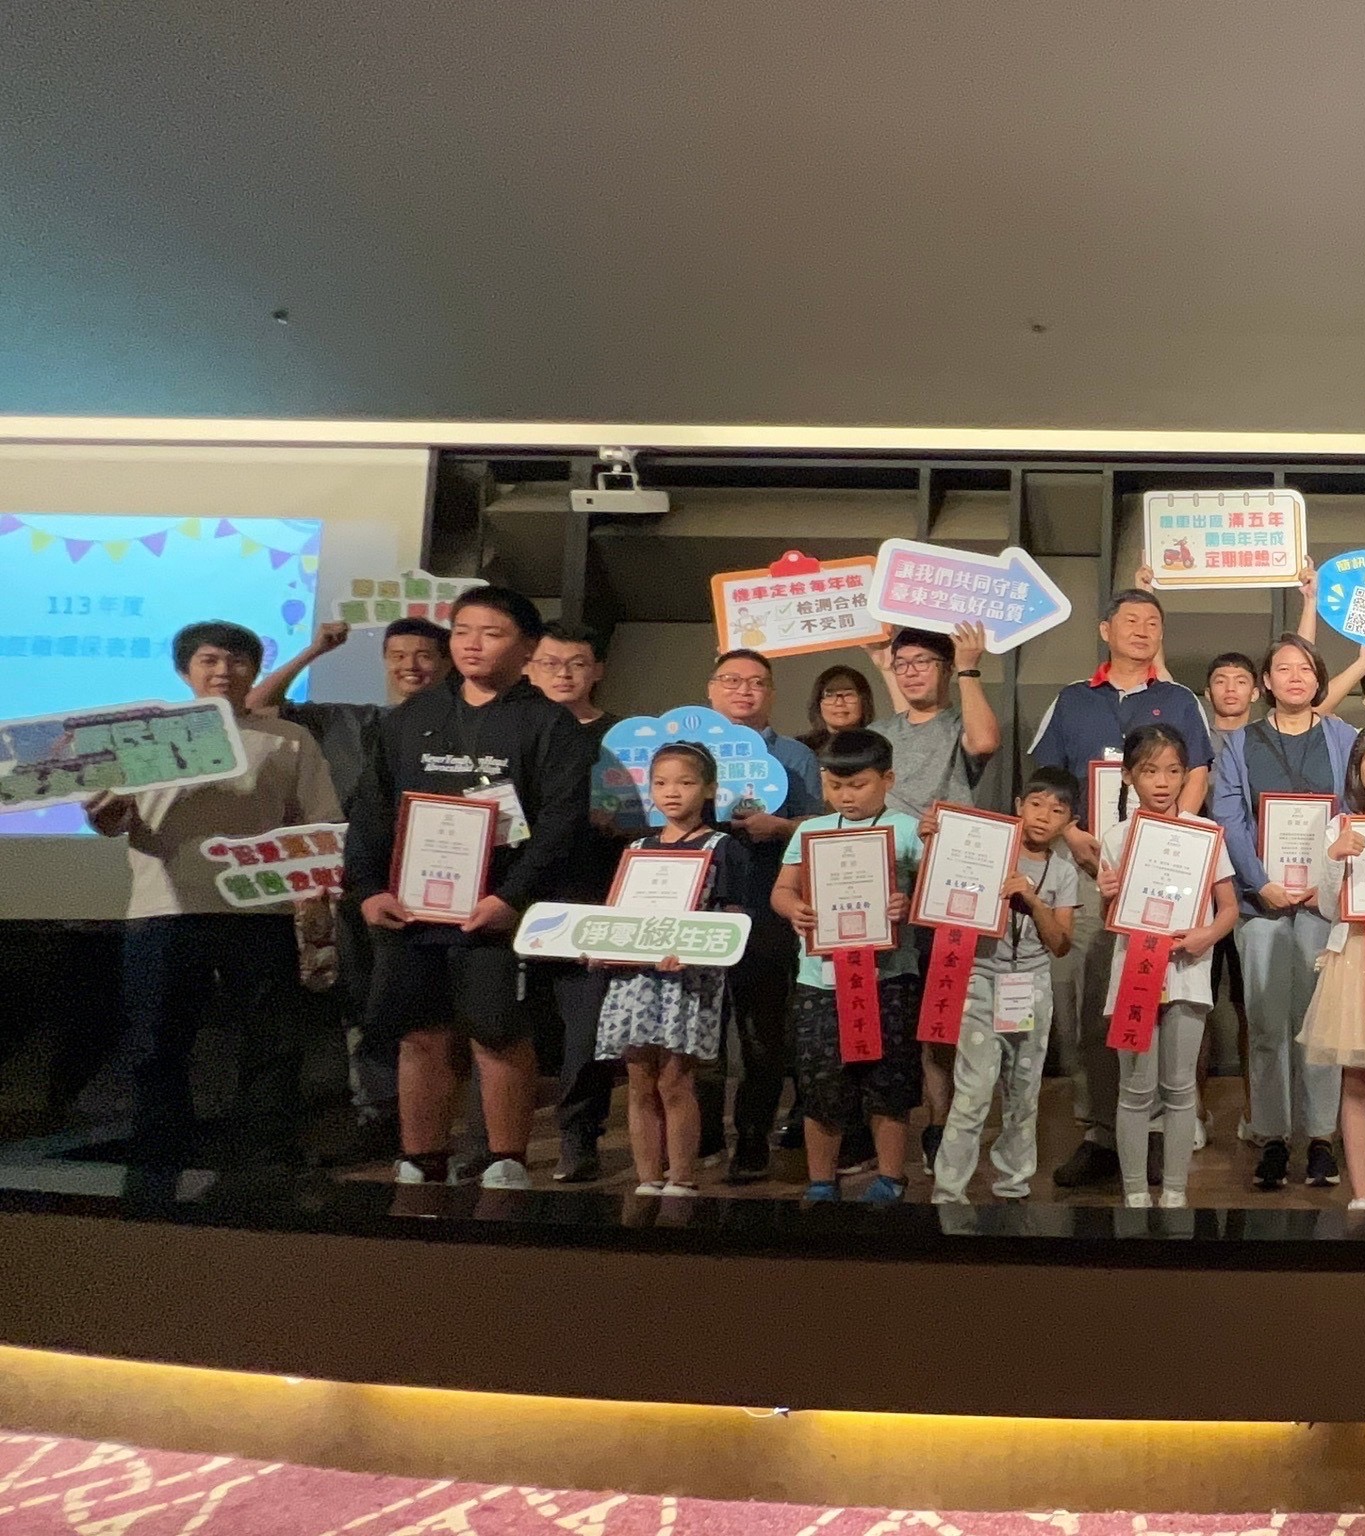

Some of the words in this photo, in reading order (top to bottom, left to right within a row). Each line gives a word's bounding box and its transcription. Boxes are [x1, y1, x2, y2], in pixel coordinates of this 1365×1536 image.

[893, 557, 1032, 602] 讓我們共同守護
[796, 593, 868, 616] 檢測合格
[888, 580, 1025, 625] 臺東空氣好品質
[800, 614, 857, 634] 不受罰
[577, 915, 733, 954] 淨零綠生活
